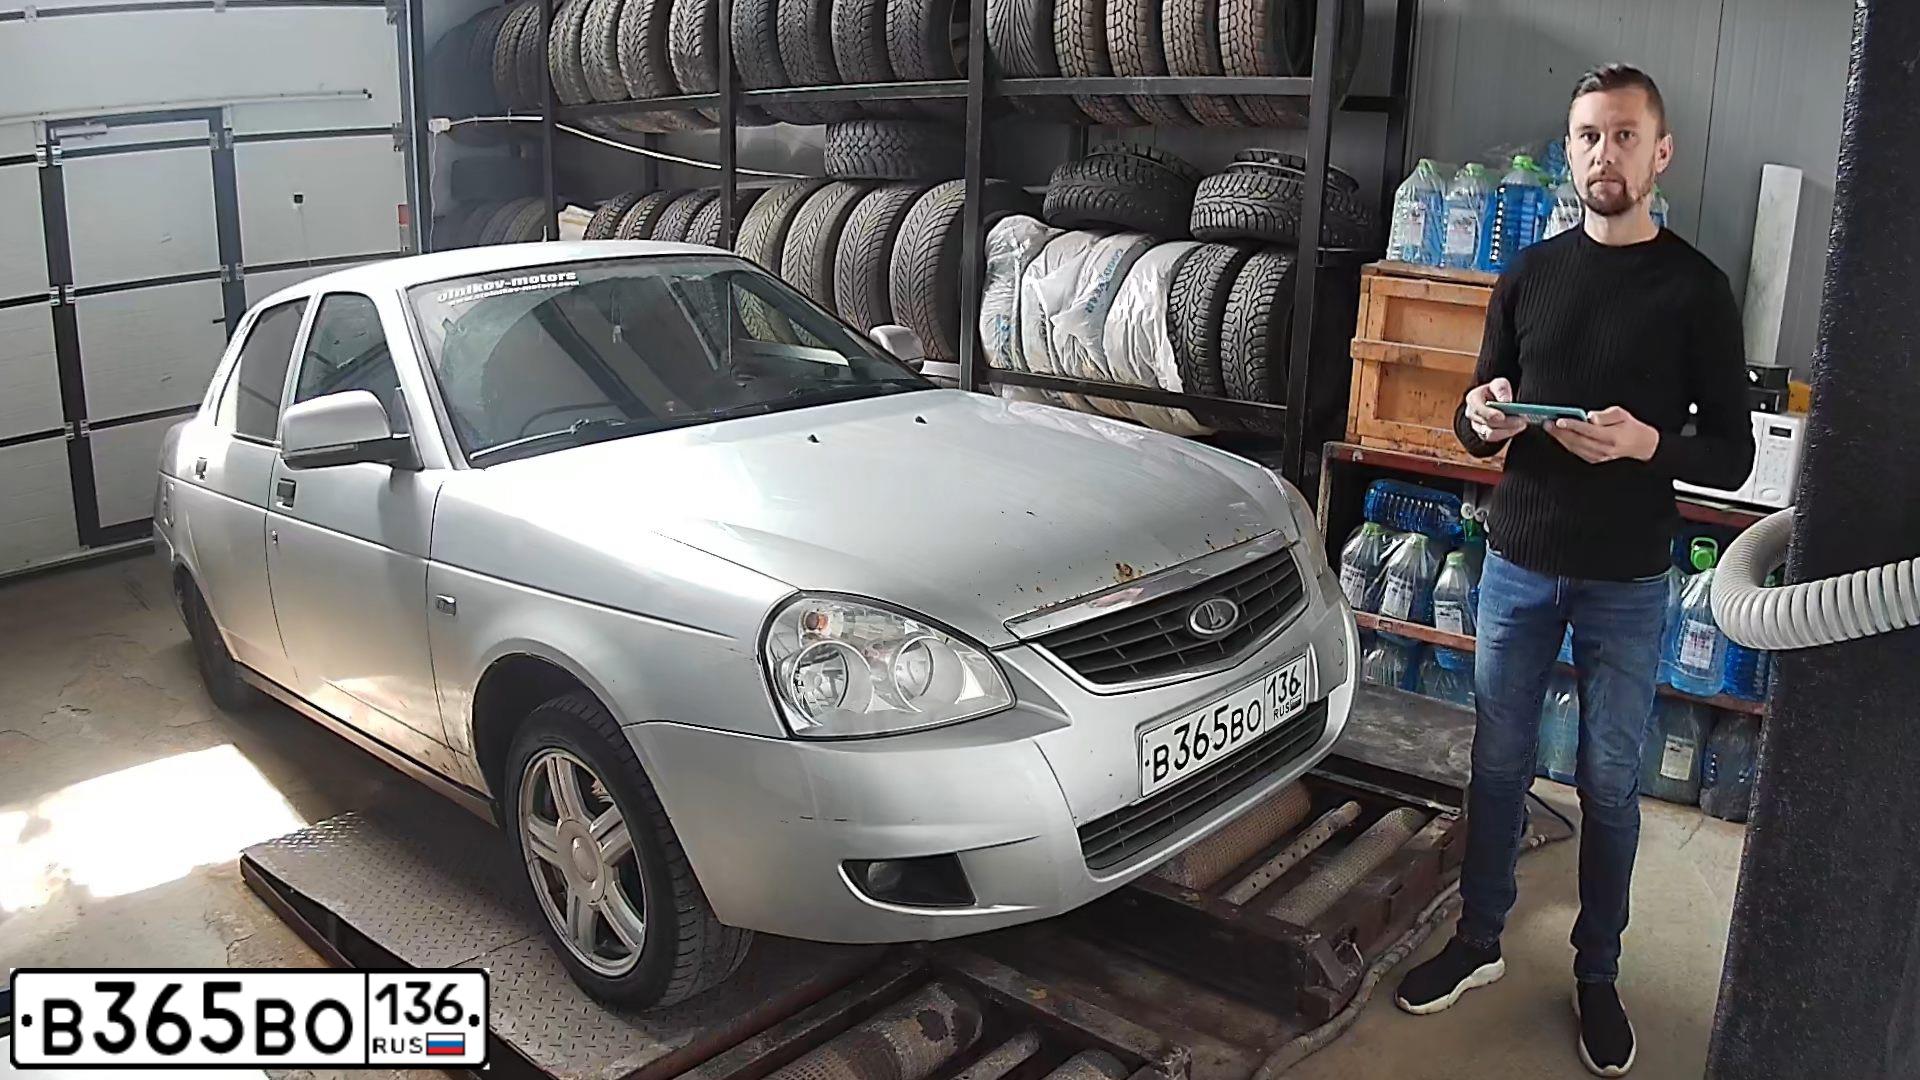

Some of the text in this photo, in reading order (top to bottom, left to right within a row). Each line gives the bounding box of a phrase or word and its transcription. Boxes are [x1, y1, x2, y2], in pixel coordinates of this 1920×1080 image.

[1153, 664, 1302, 783] В365ВО 136
[1273, 703, 1290, 721] RUS
